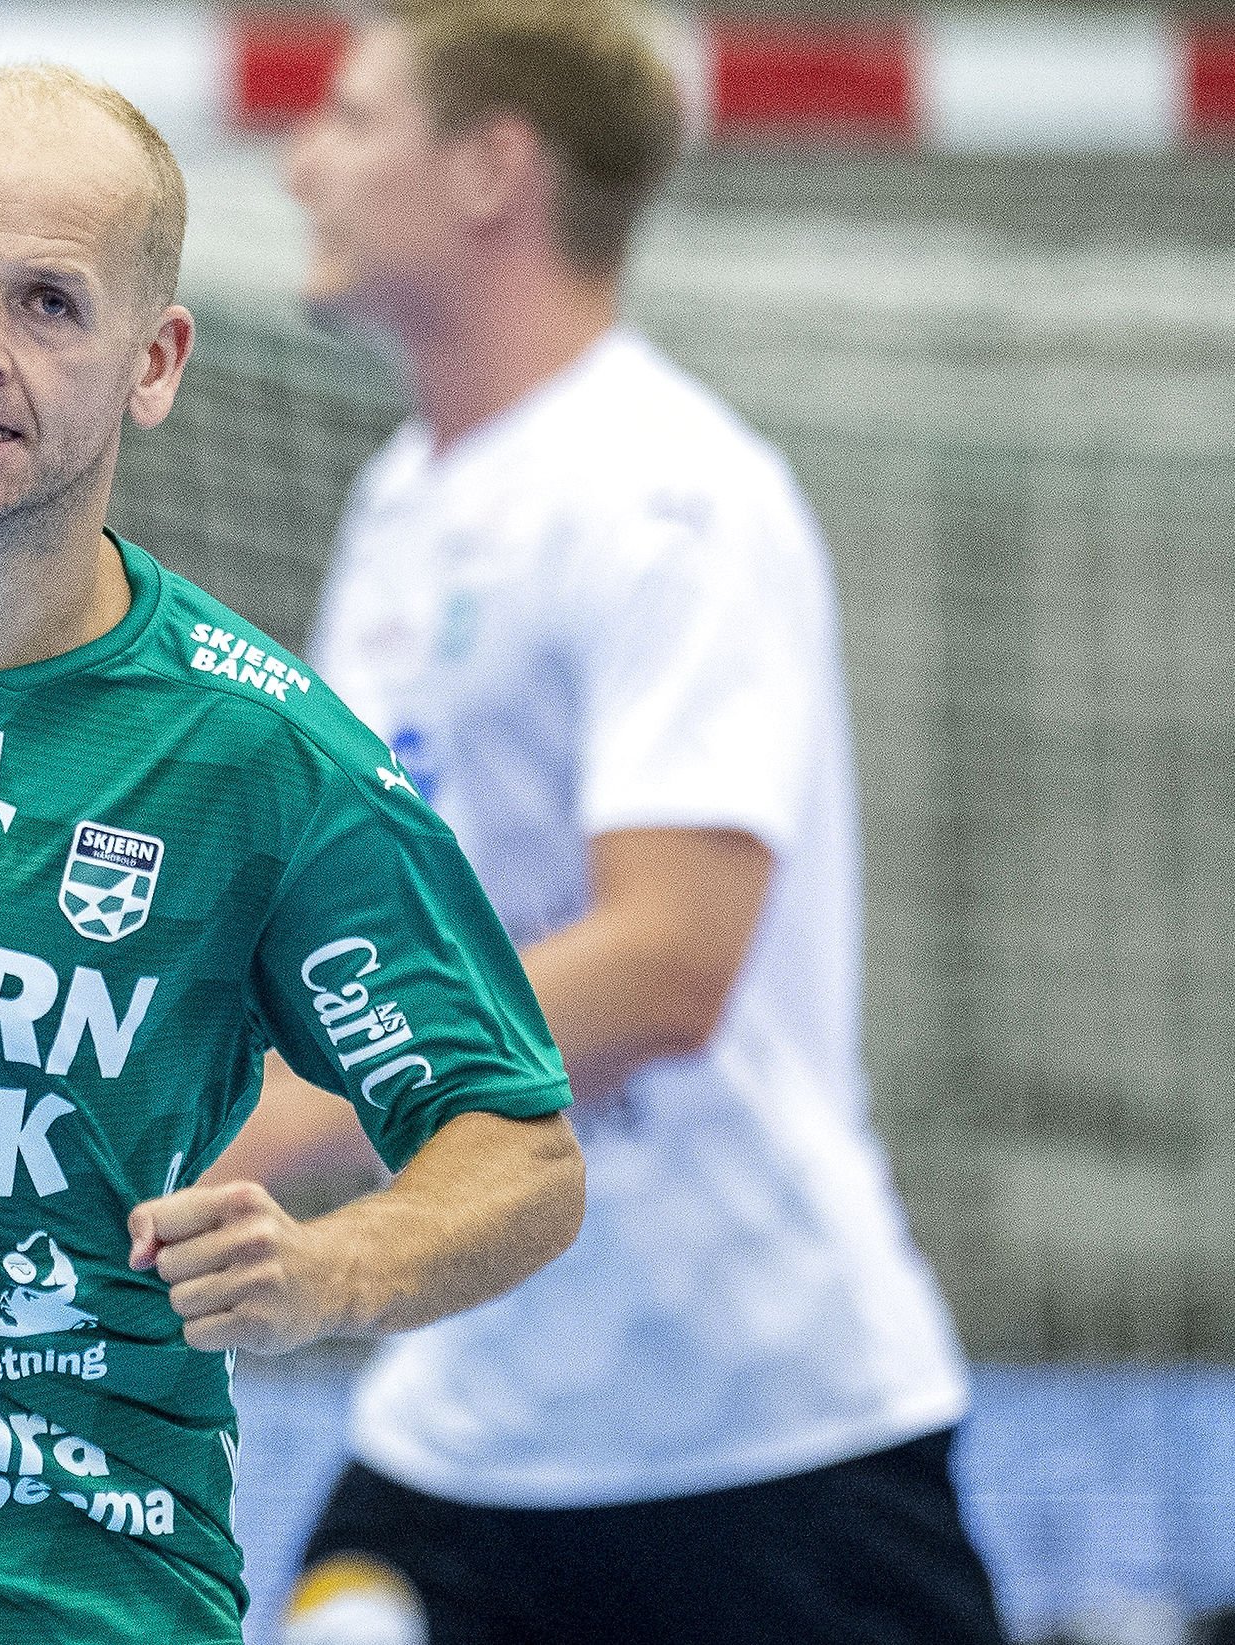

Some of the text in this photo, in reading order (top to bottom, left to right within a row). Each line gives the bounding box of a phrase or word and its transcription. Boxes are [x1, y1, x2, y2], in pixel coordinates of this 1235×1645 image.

[190, 623, 311, 694] SKJERN
[190, 646, 289, 702] BANK
[82, 829, 155, 862] SKJERN
